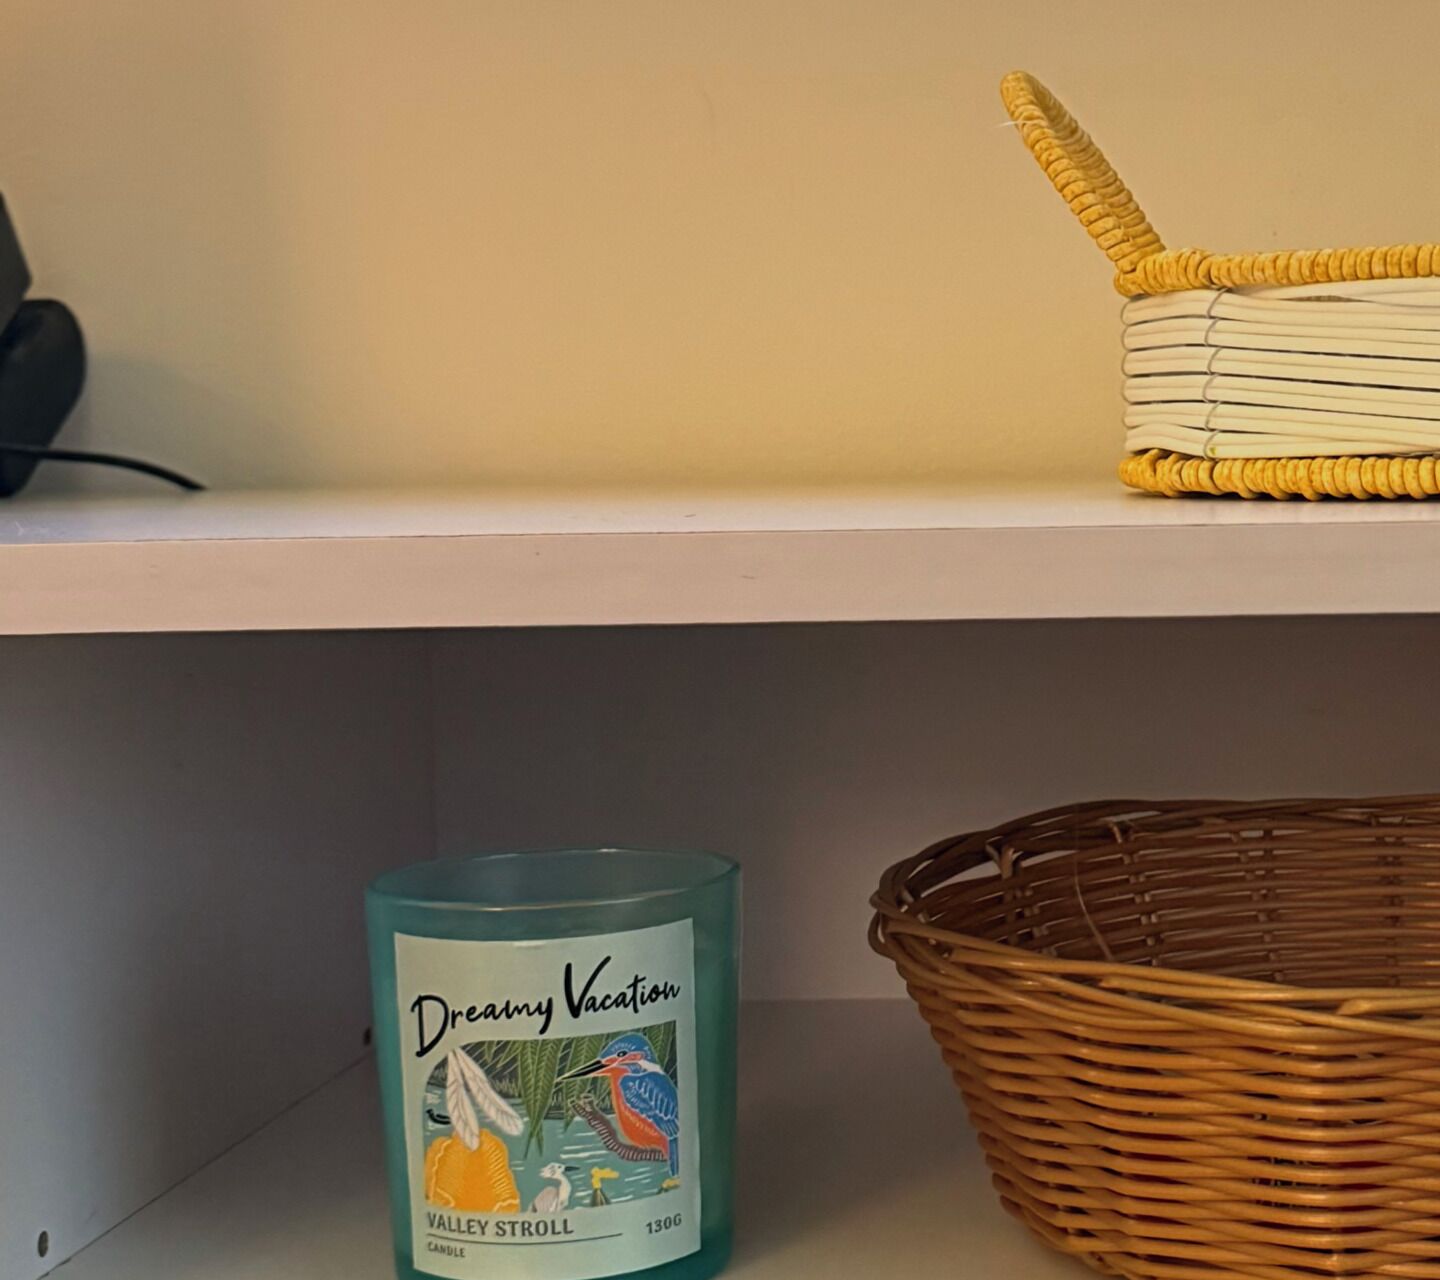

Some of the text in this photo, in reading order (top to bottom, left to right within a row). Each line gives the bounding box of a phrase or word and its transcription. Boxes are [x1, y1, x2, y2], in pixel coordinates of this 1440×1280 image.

[411, 956, 681, 1058] Dreamy Vacation
[427, 1212, 574, 1238] VALLEY STROLL
[645, 1213, 682, 1235] 130G
[427, 1241, 466, 1259] CANDLE
